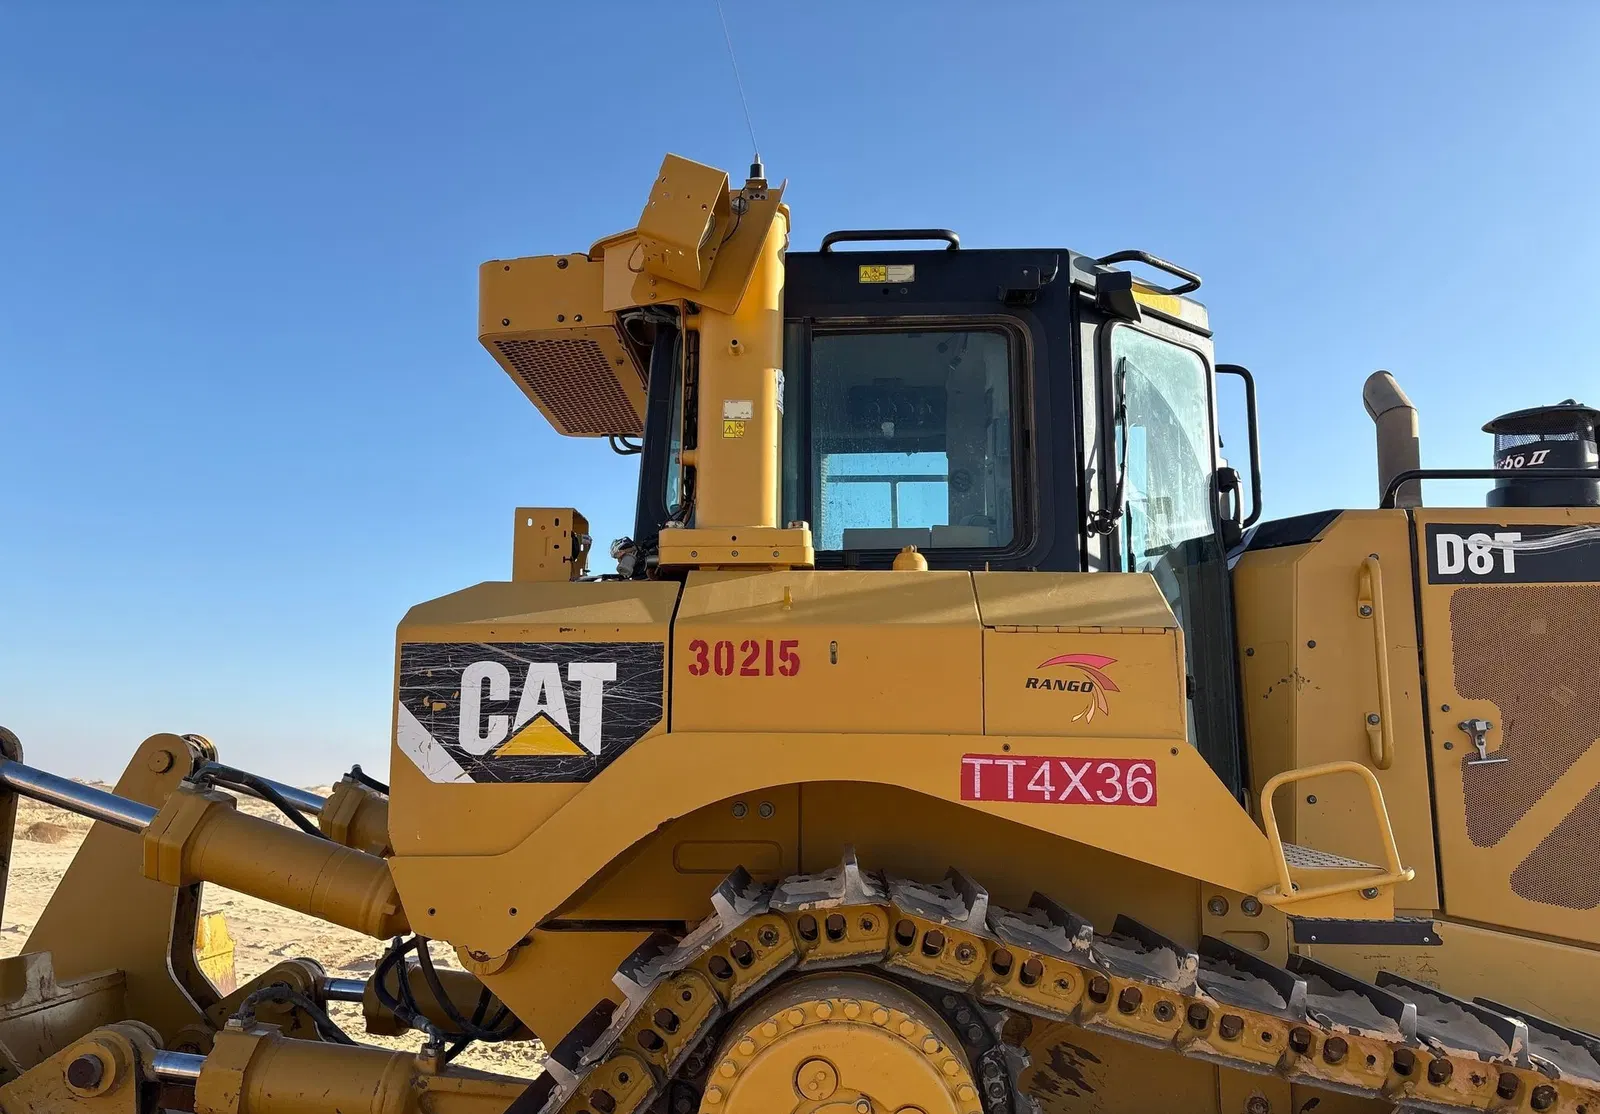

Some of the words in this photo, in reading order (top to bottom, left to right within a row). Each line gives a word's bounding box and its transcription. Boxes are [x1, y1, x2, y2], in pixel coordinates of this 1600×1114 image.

[1436, 532, 1522, 575] D8T
[688, 639, 800, 677] 30215
[1025, 677, 1094, 693] RANGO
[458, 660, 617, 756] CAT
[962, 757, 1154, 804] TT4X36
